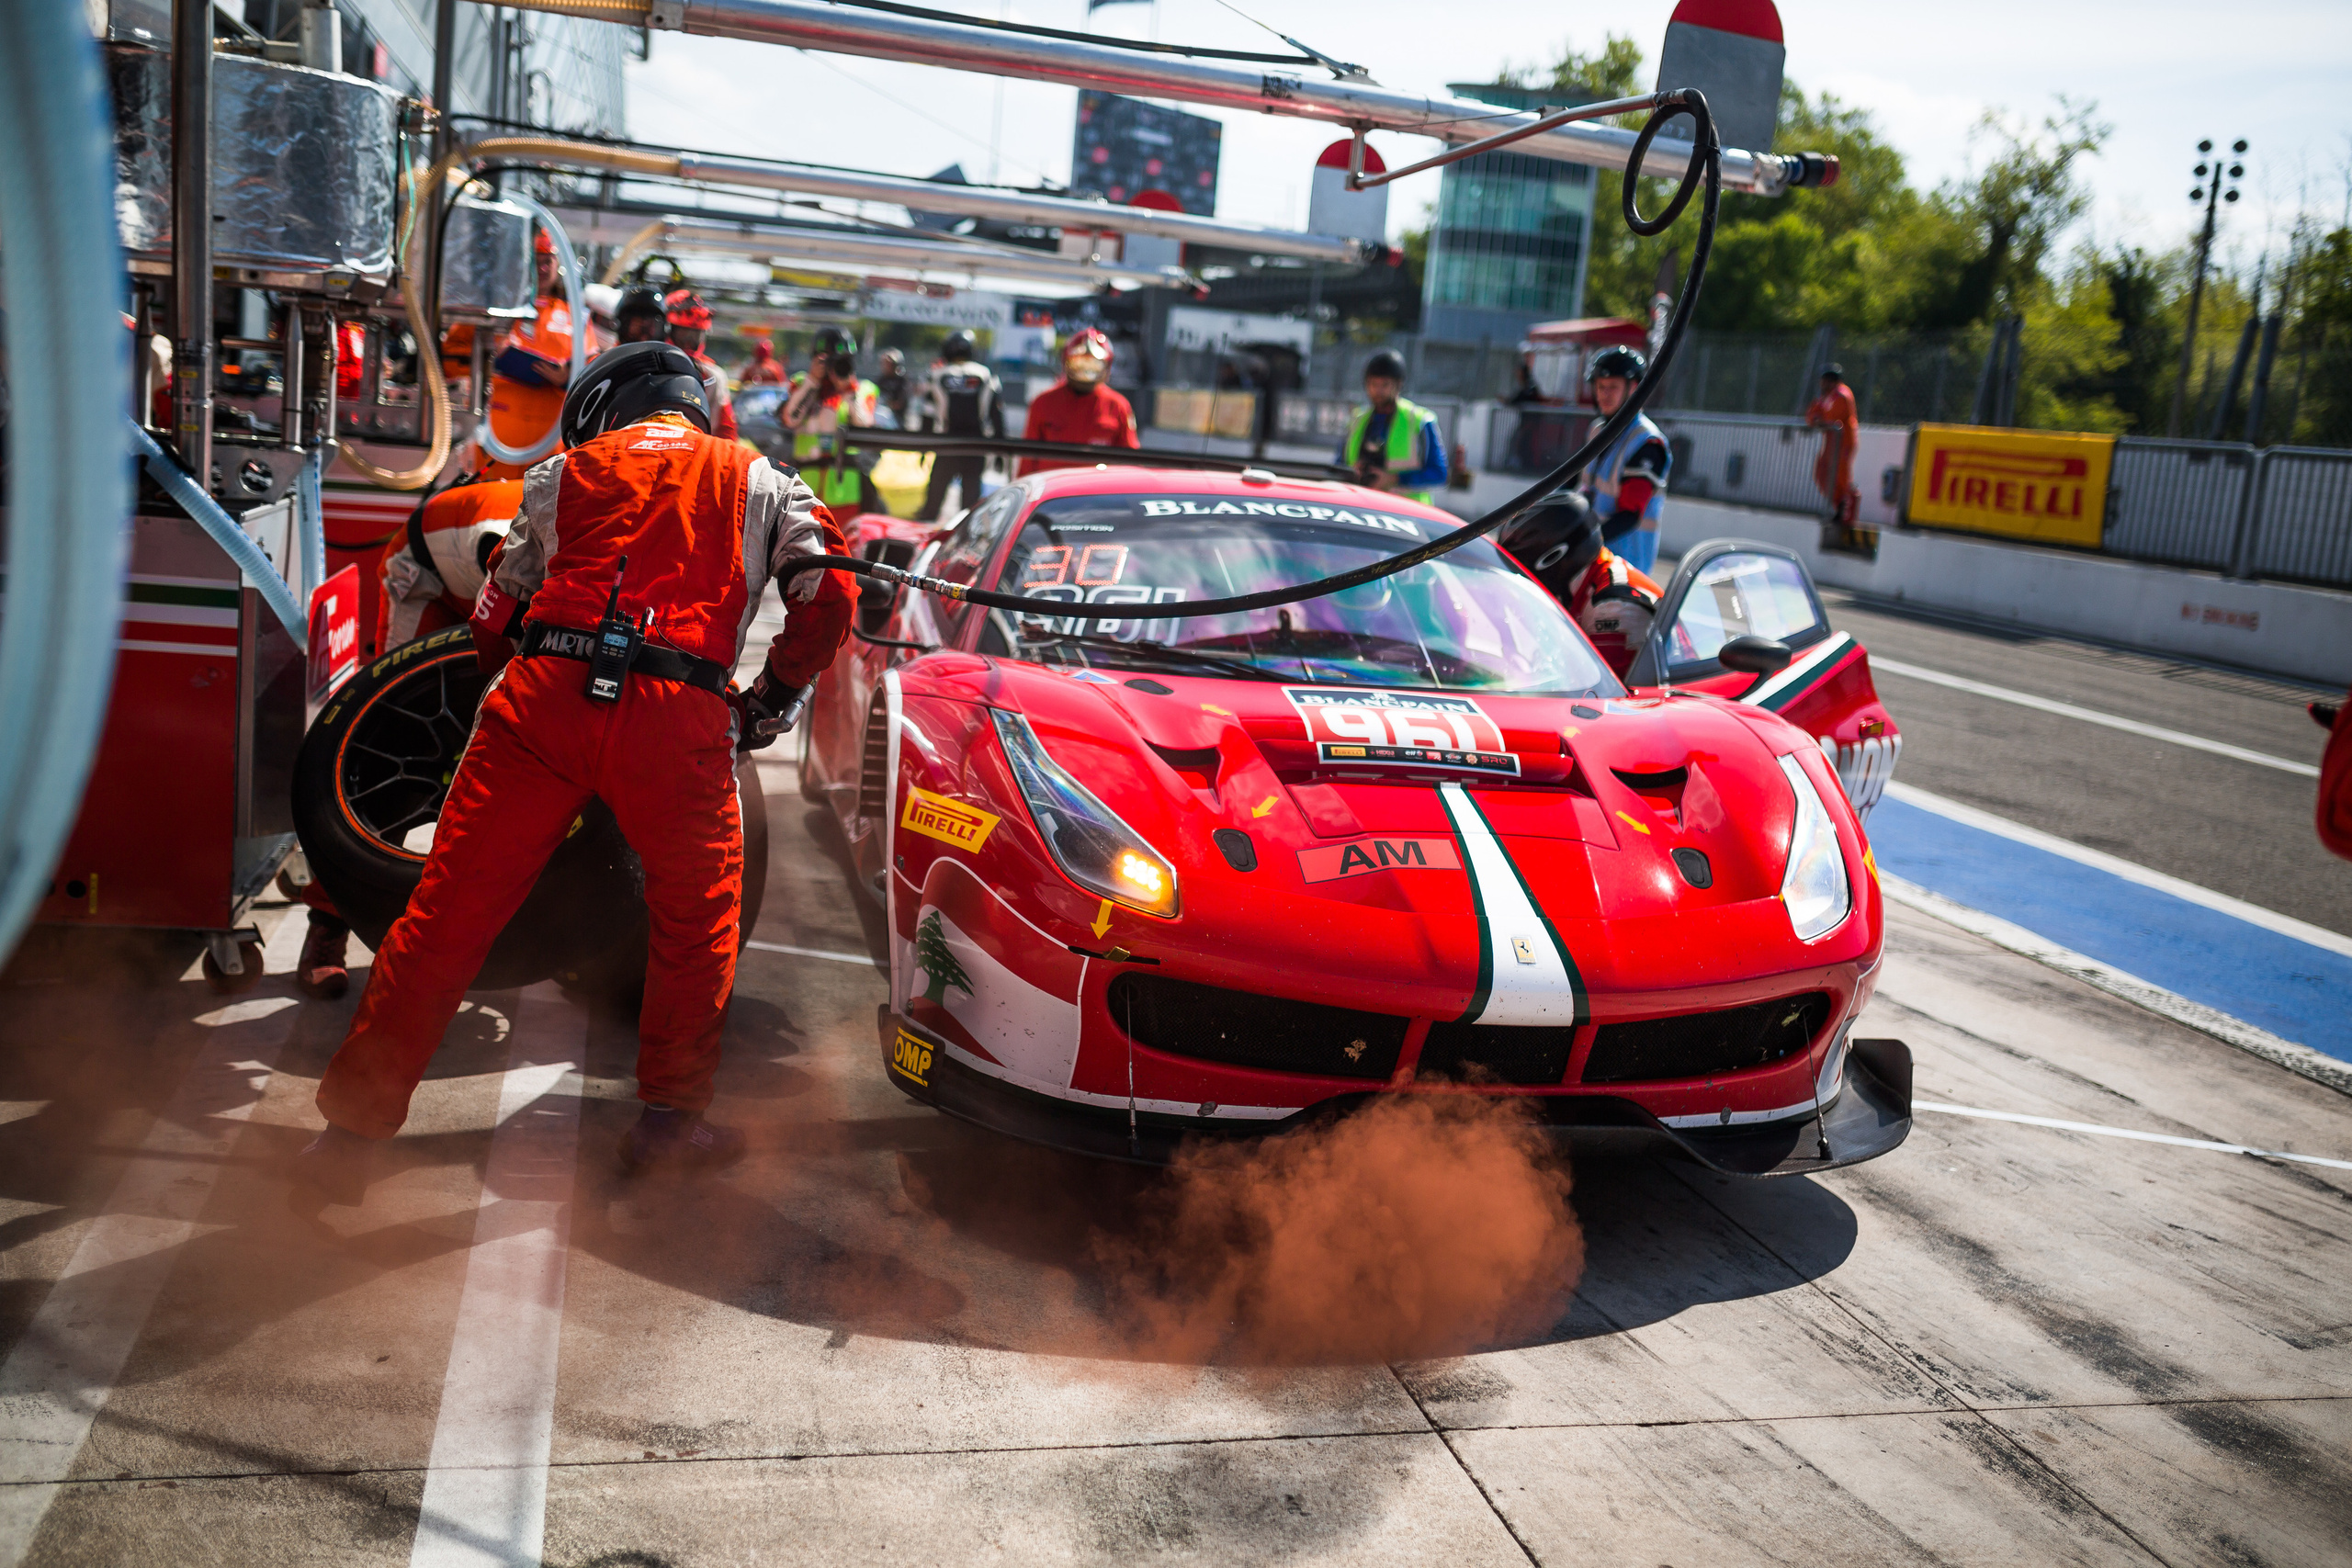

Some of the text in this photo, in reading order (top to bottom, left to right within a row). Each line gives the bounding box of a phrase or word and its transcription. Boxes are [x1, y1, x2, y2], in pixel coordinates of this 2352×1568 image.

[1928, 447, 2088, 521] PIRELLI
[1140, 499, 1419, 536] BLANCPAIN
[1024, 545, 1129, 588] 30
[372, 629, 474, 678] PIREL
[1299, 694, 1470, 714] BLANCPAIN
[1319, 706, 1477, 750] 961
[1481, 756, 1508, 764] SRO
[909, 797, 984, 842] PIRELLI
[1340, 840, 1427, 874] AM
[894, 1036, 932, 1076] OMP
